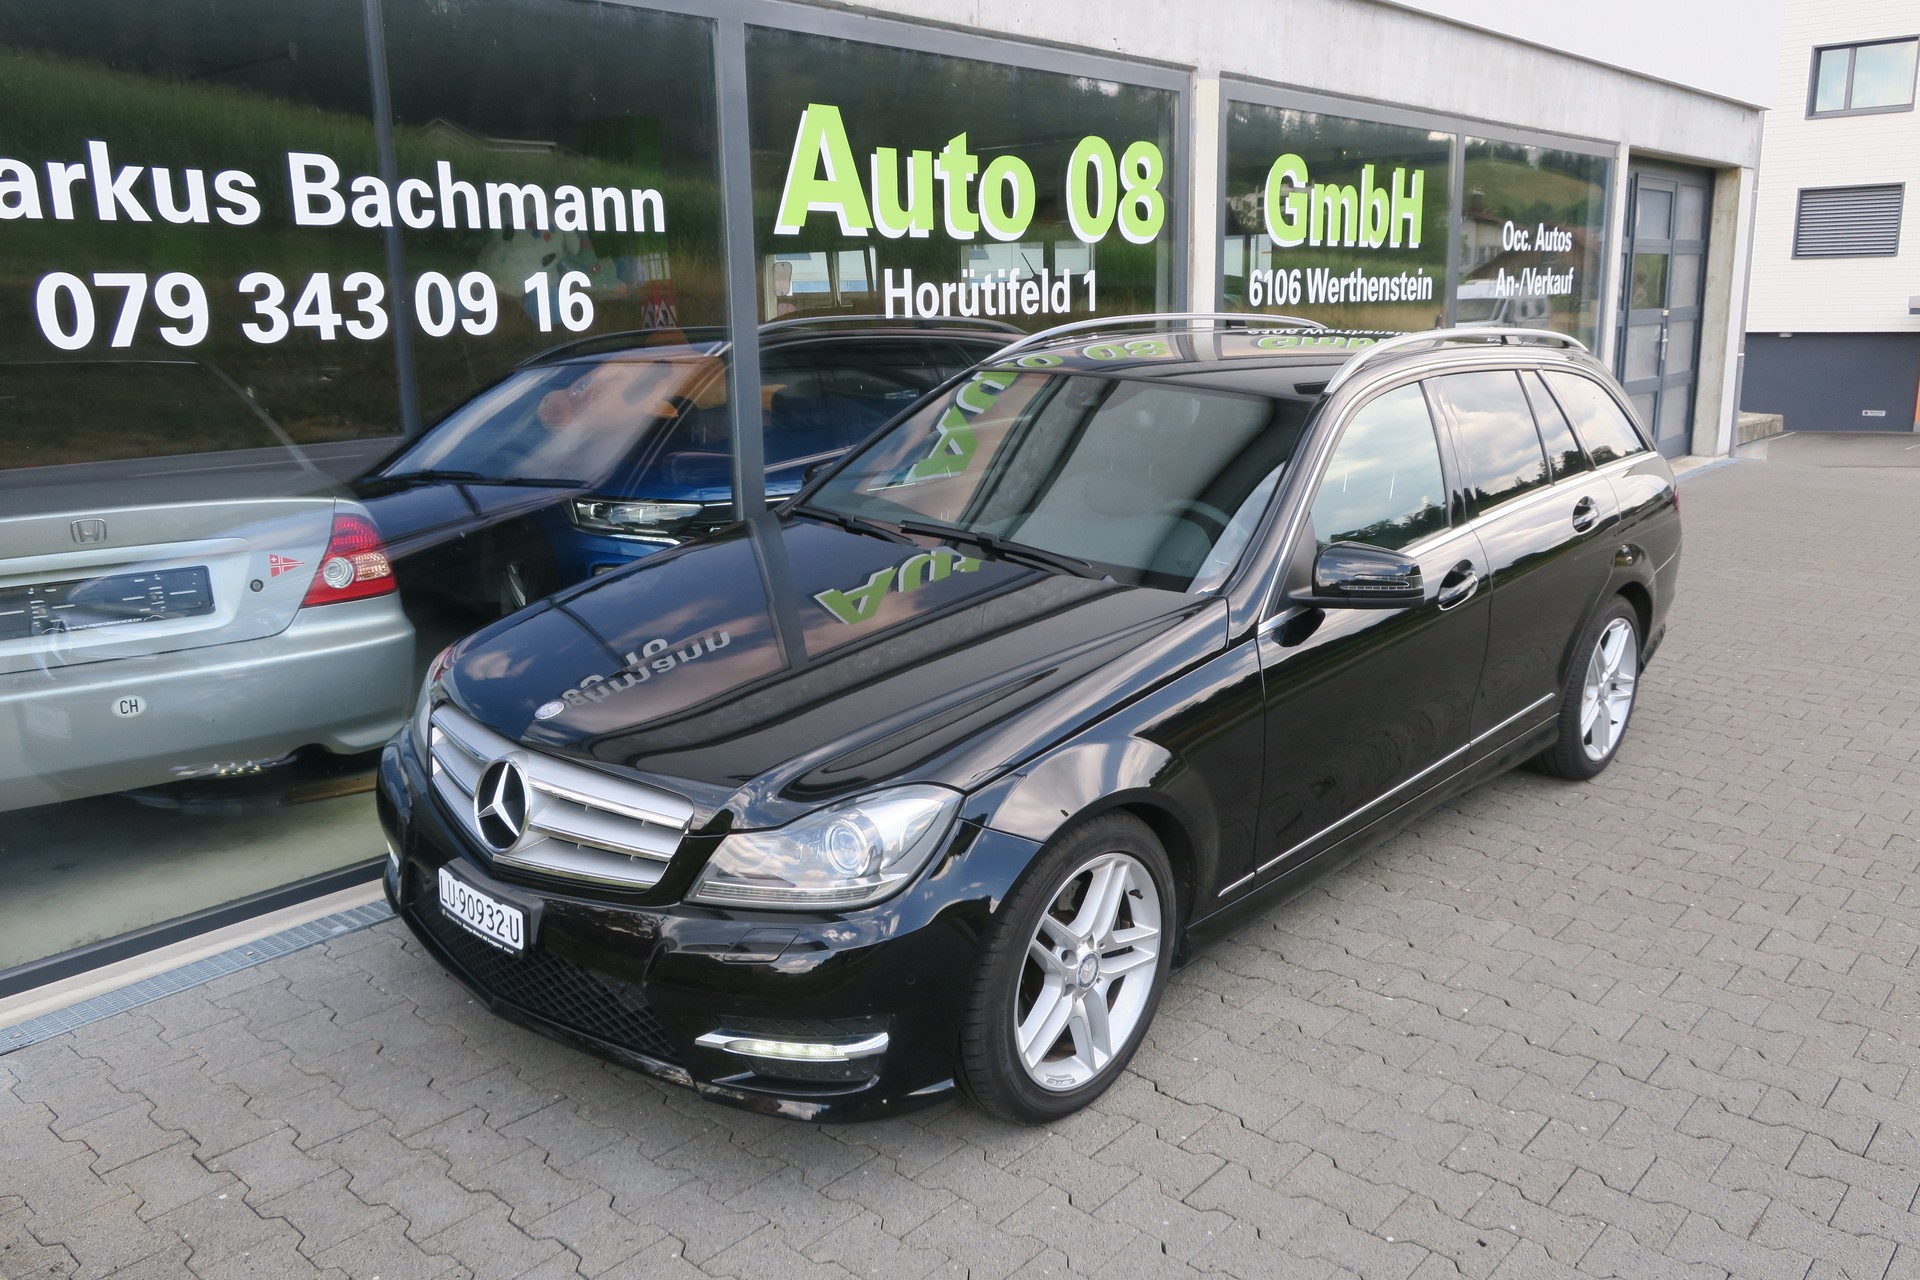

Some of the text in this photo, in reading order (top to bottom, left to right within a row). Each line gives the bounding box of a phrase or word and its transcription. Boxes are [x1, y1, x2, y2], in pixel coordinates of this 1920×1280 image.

[0, 140, 665, 233] arkus Bachmann
[773, 103, 1165, 244] Auto 08
[1264, 154, 1425, 249] GmbH
[1502, 220, 1573, 252] Occ. Autos
[884, 268, 1096, 319] Horütifeld 1
[1249, 267, 1433, 307] 6106 Werthenstein
[1494, 266, 1575, 297] An-/Verkauf
[36, 270, 594, 350] 079 343 09 16
[119, 698, 139, 715] CH
